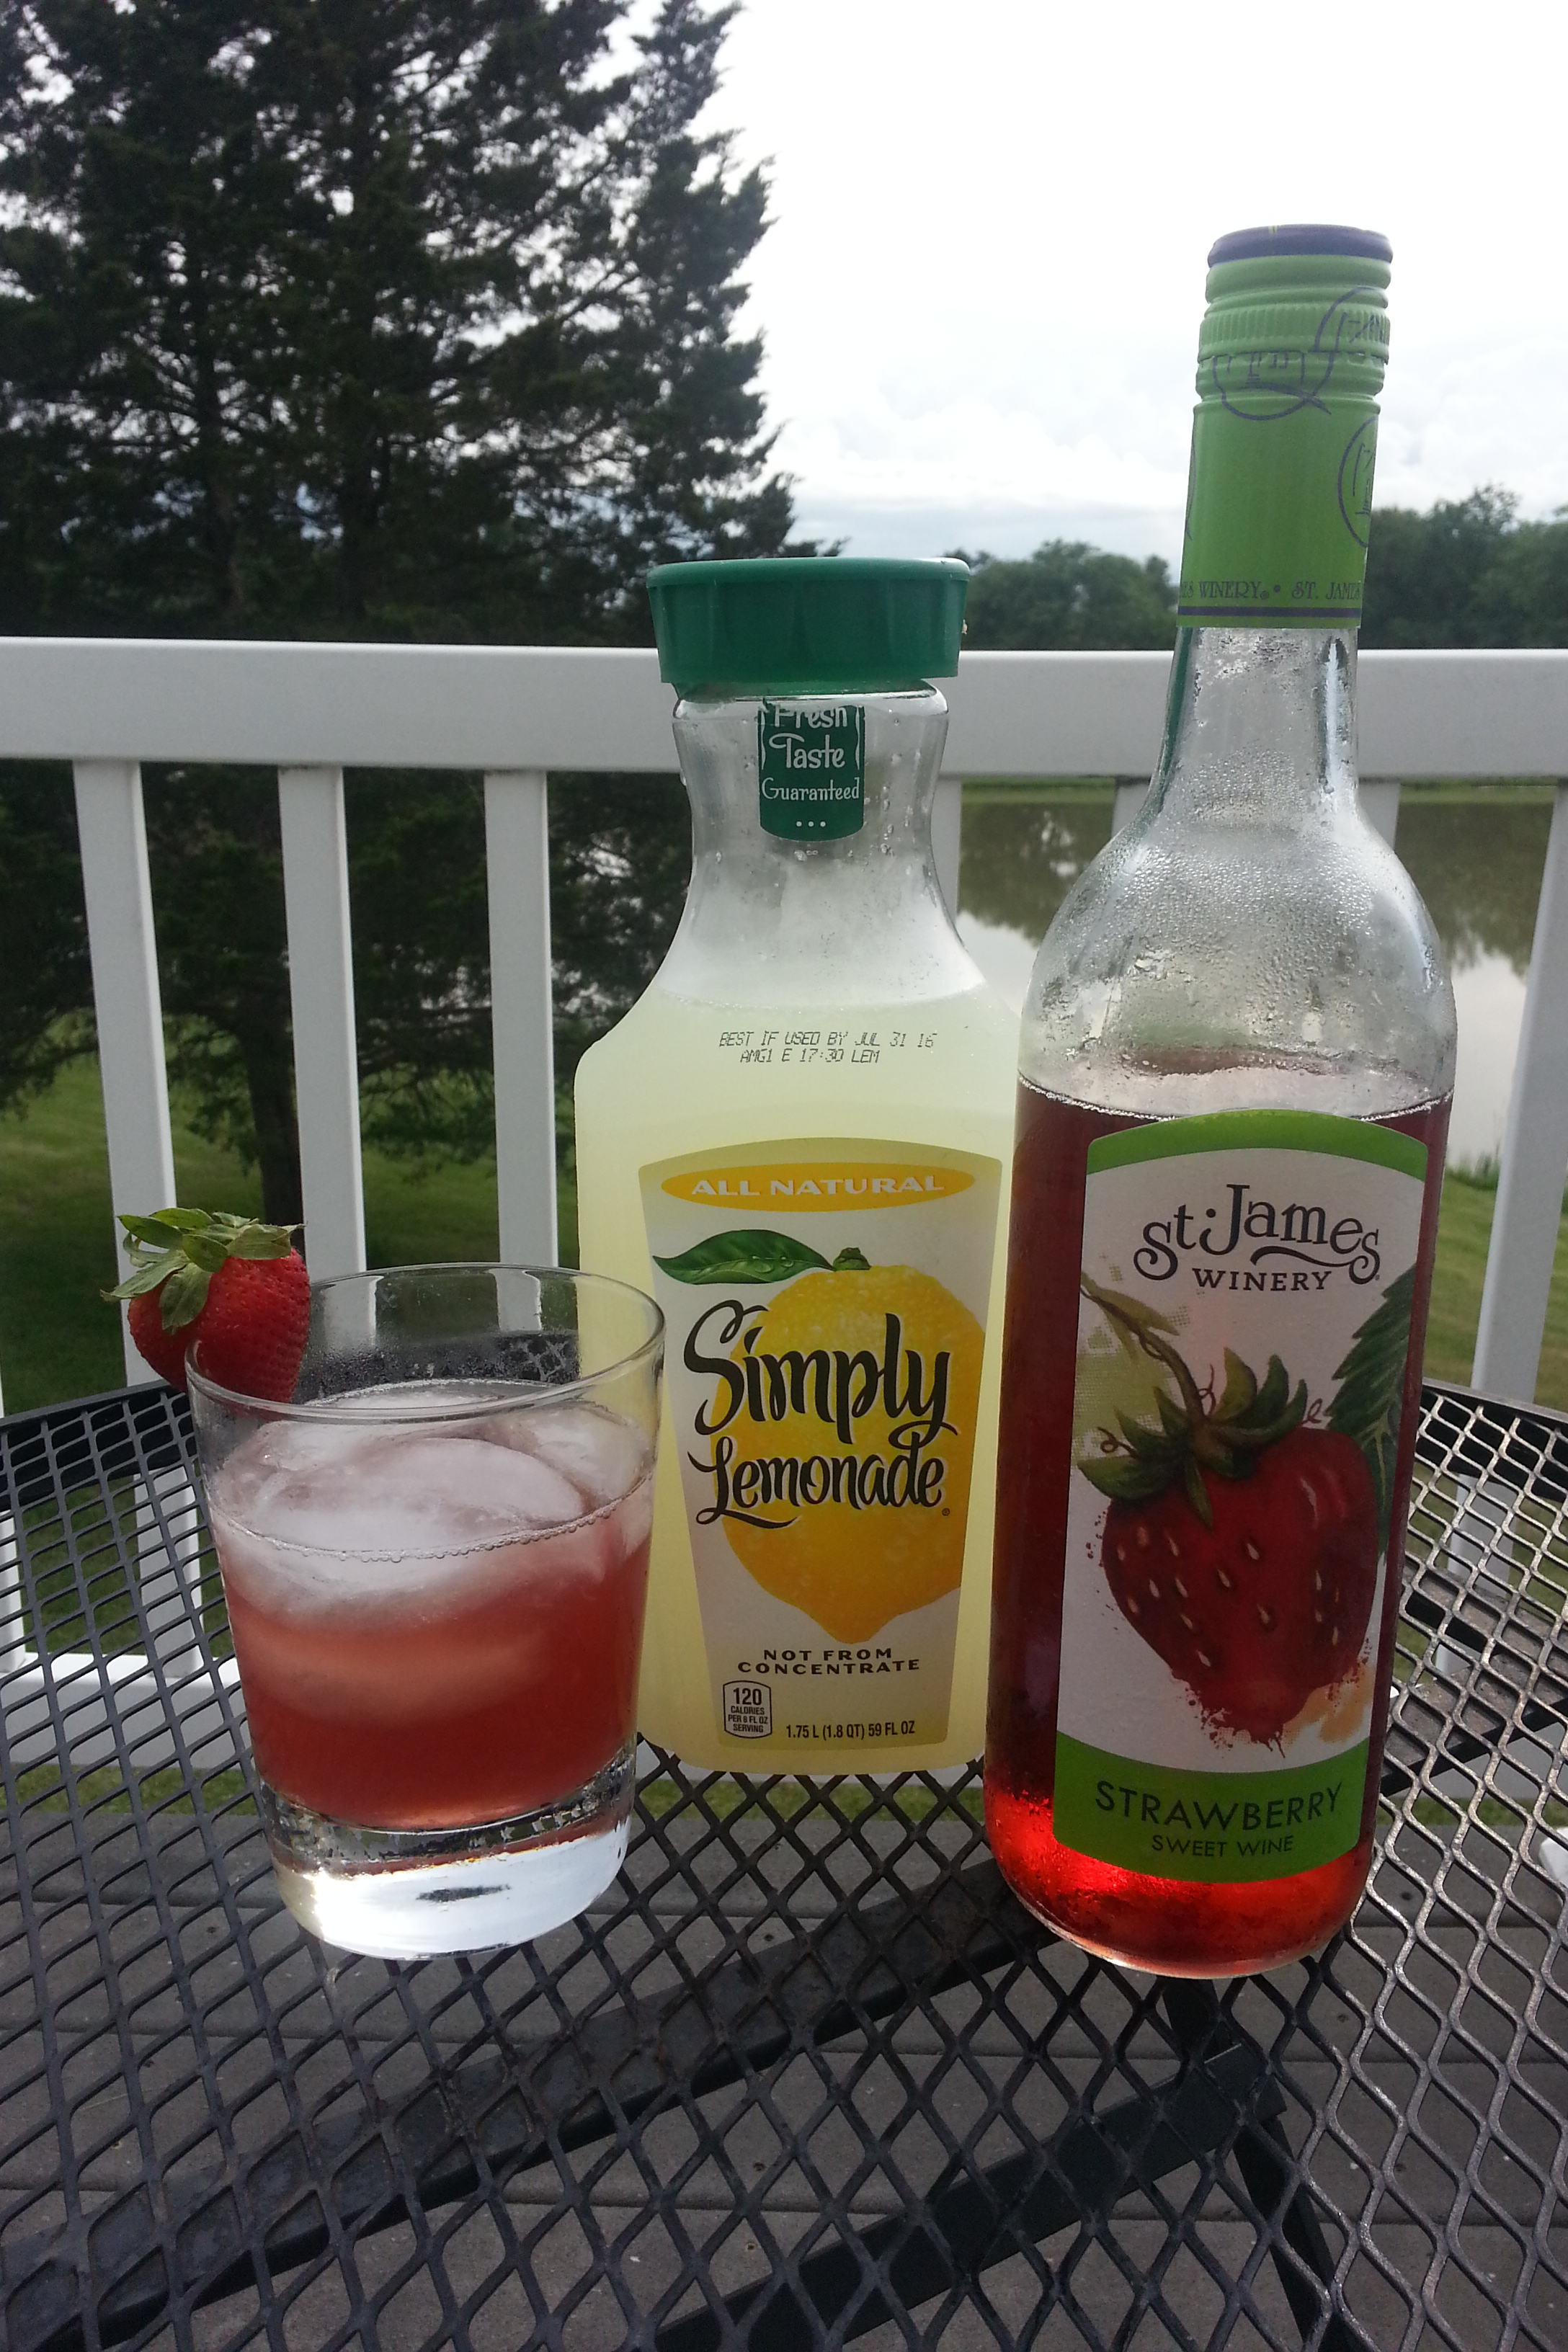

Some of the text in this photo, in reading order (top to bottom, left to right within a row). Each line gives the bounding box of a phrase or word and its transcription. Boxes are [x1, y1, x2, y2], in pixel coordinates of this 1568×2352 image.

[769, 733, 845, 769] Taste
[761, 777, 860, 801] Guaranteed
[719, 1031, 754, 1047] BEST
[761, 1030, 780, 1046] IF
[785, 1031, 821, 1045] USED
[827, 1031, 848, 1046] BY
[855, 1032, 881, 1046] JUL
[890, 1031, 906, 1047] 31
[781, 1048, 793, 1062] E
[851, 1048, 881, 1064] LEM
[691, 1175, 945, 1196] ALL NATURAL
[1192, 1268, 1332, 1291] WINERY
[683, 1299, 959, 1450] Simply
[687, 1431, 945, 1528] Lemonade
[764, 1648, 892, 1661] NOT FROM
[738, 1659, 920, 1675] CONCENTRATE
[734, 1688, 762, 1705] 120
[731, 1706, 765, 1715] CALORIES
[733, 1724, 764, 1733] SERVING
[786, 1720, 916, 1741] 1.75 L (1.8 QT) 59 FL OZ
[1095, 1781, 1342, 1831] STRAWBERRY
[1152, 1835, 1293, 1857] SWEET WINE
